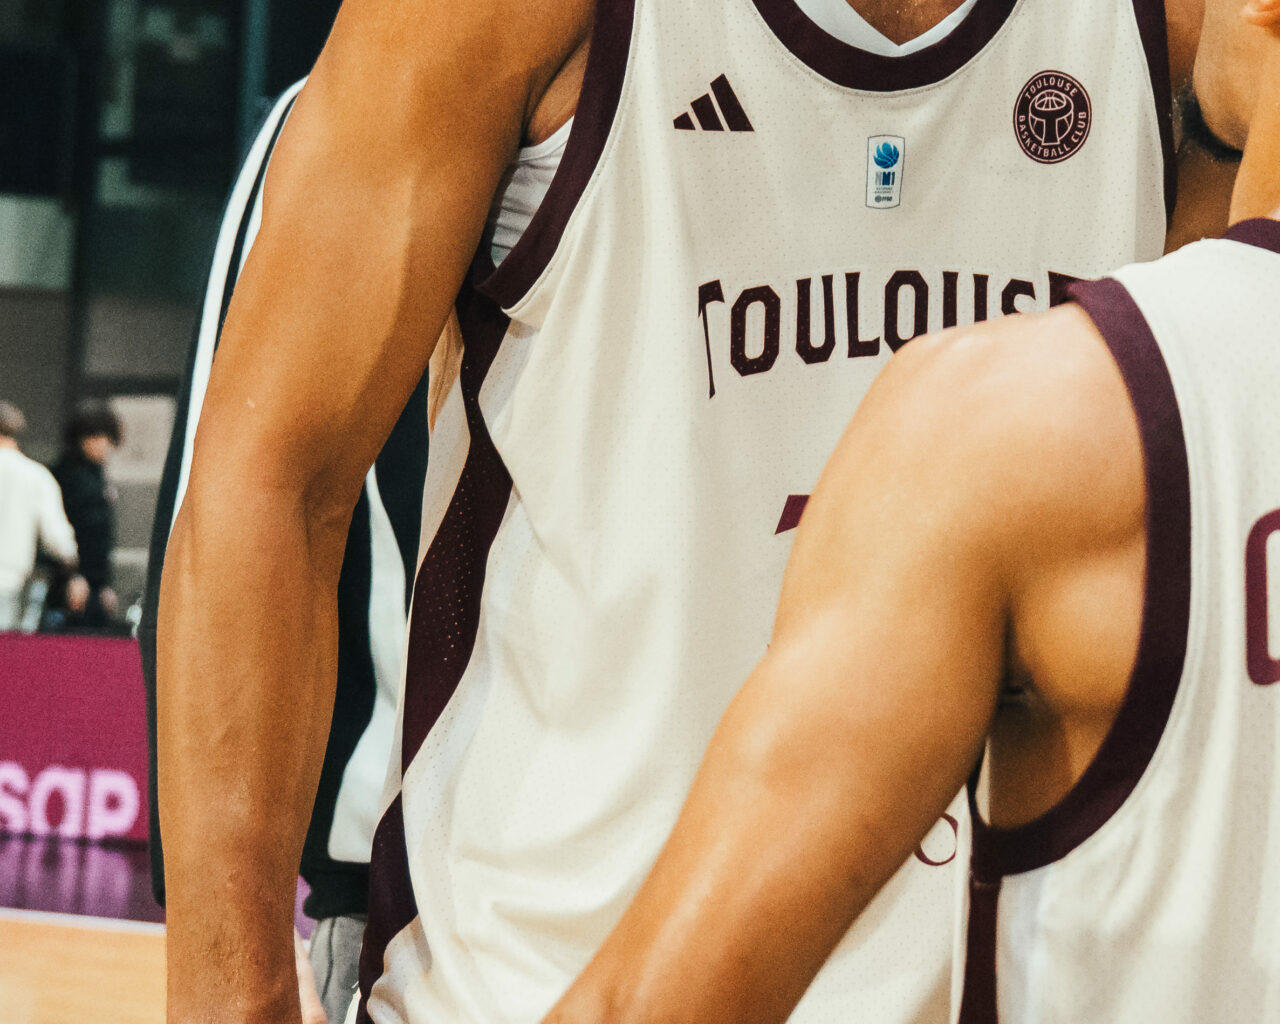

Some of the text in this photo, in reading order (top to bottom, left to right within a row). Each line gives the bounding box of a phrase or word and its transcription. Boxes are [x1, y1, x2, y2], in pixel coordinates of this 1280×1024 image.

[1025, 77, 1078, 99] TOULOUSE
[1019, 112, 1087, 157] BASKETBALL CLUB
